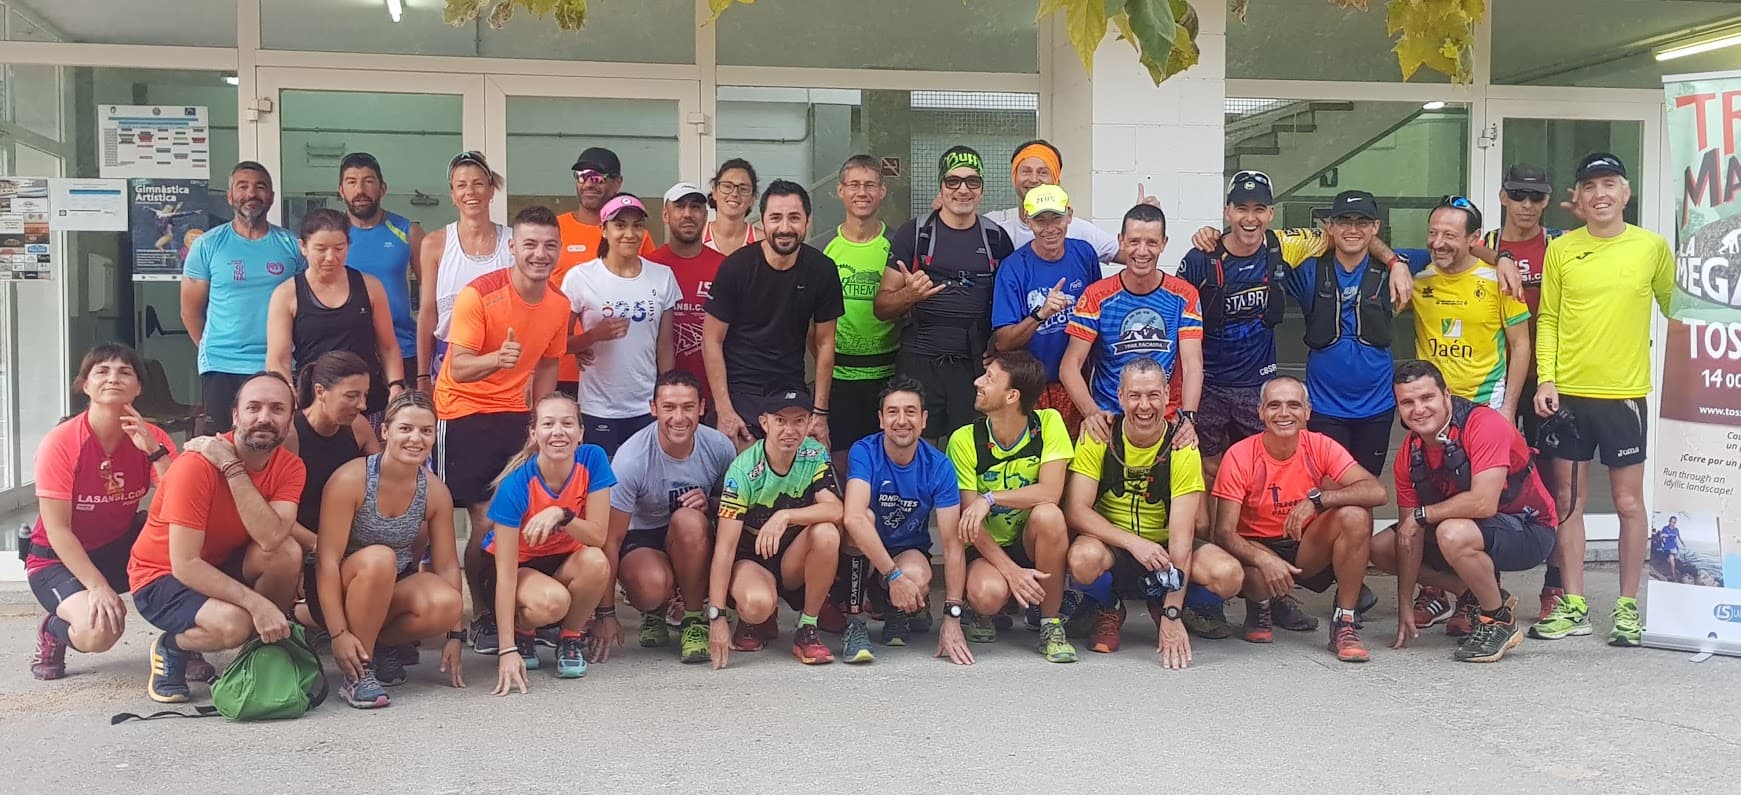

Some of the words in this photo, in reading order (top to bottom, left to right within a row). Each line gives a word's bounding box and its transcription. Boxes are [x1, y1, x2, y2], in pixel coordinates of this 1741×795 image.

[1427, 338, 1473, 359] Jaén
[1701, 368, 1723, 388] 14
[1707, 458, 1724, 466] por
[1679, 471, 1712, 484] through
